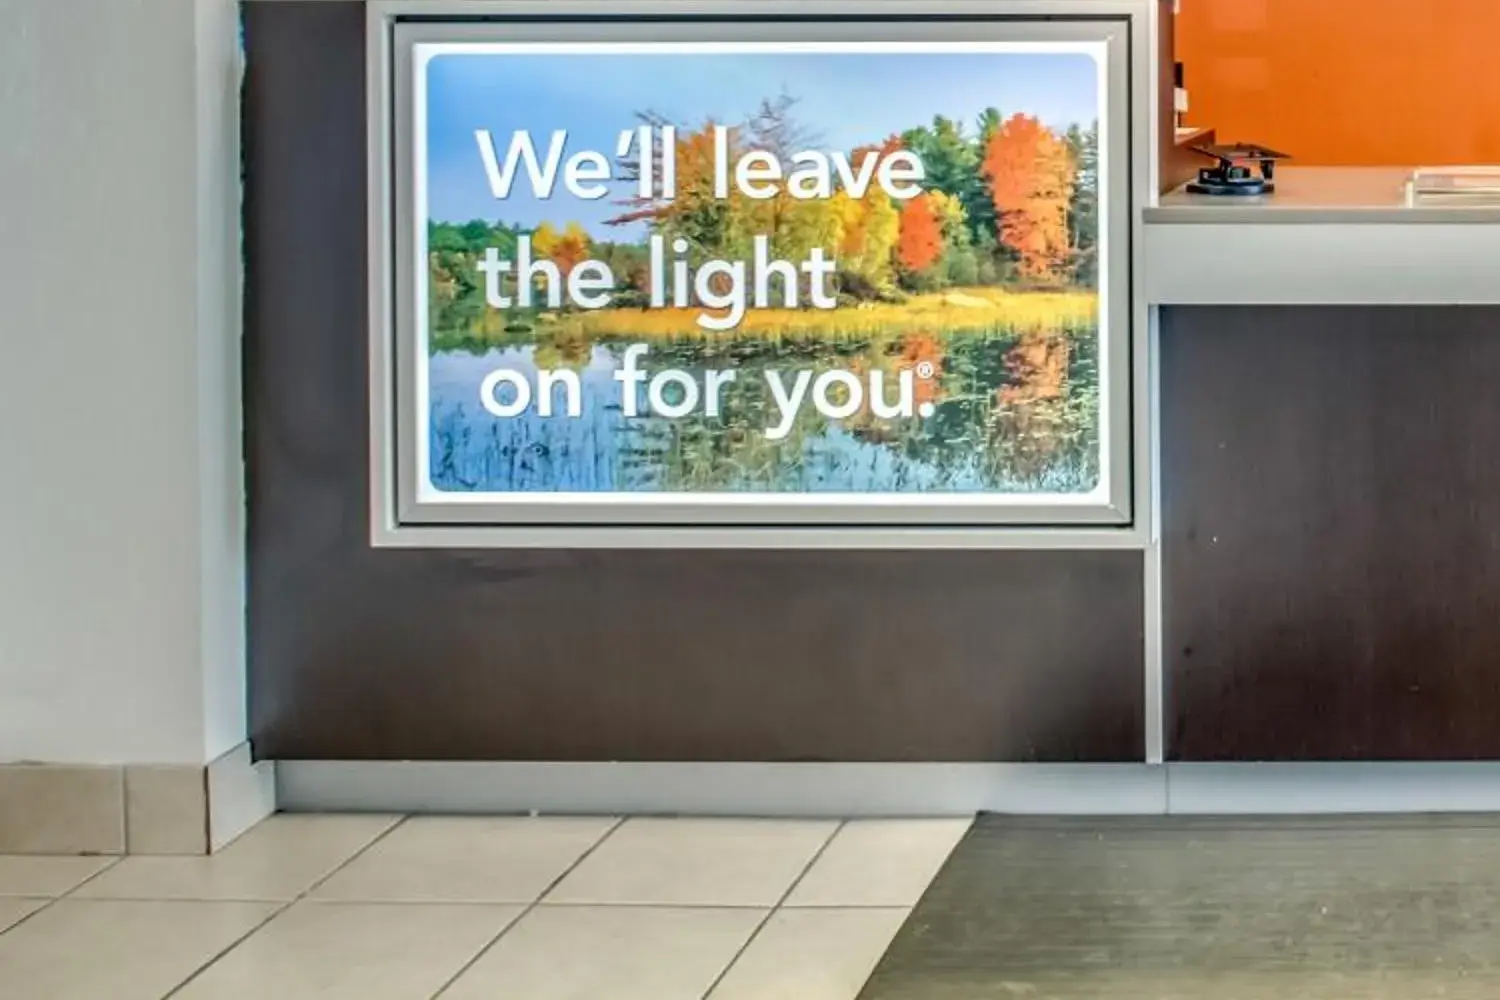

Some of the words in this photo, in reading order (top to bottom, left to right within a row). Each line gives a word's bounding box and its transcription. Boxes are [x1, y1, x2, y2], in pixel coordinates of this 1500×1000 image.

[475, 126, 675, 200] We'll
[714, 126, 925, 200] leave
[477, 235, 614, 309] the
[650, 234, 837, 331] light
[480, 367, 581, 418] on
[614, 344, 735, 418] for
